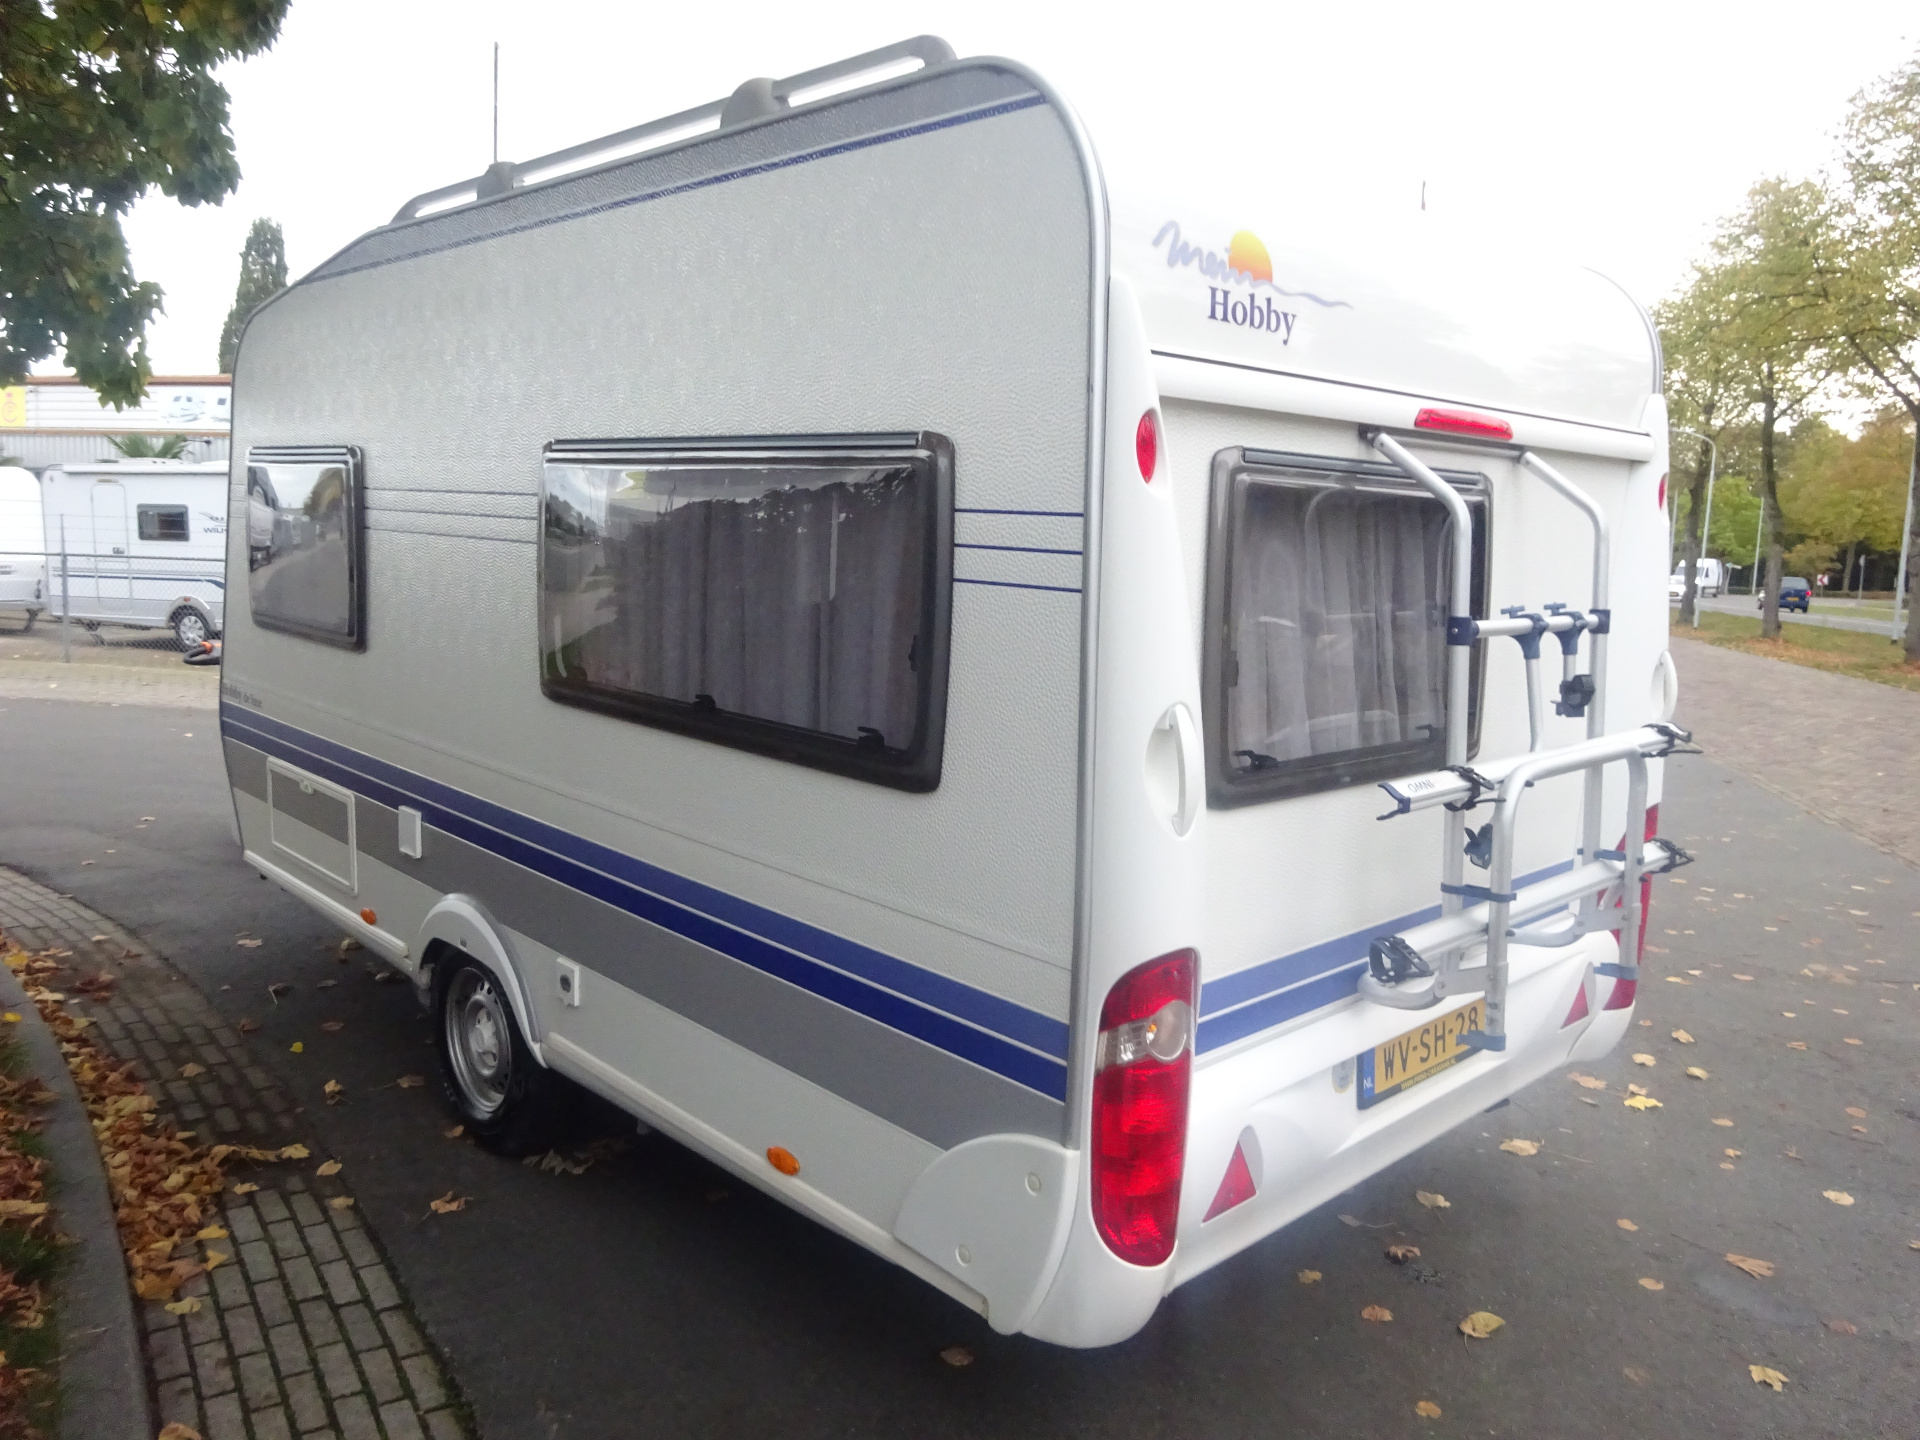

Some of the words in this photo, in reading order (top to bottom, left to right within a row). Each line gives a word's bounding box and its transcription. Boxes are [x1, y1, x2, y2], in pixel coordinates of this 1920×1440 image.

[1208, 286, 1297, 345] Hobby
[1408, 779, 1435, 793] OMNI
[1363, 1076, 1373, 1090] NL
